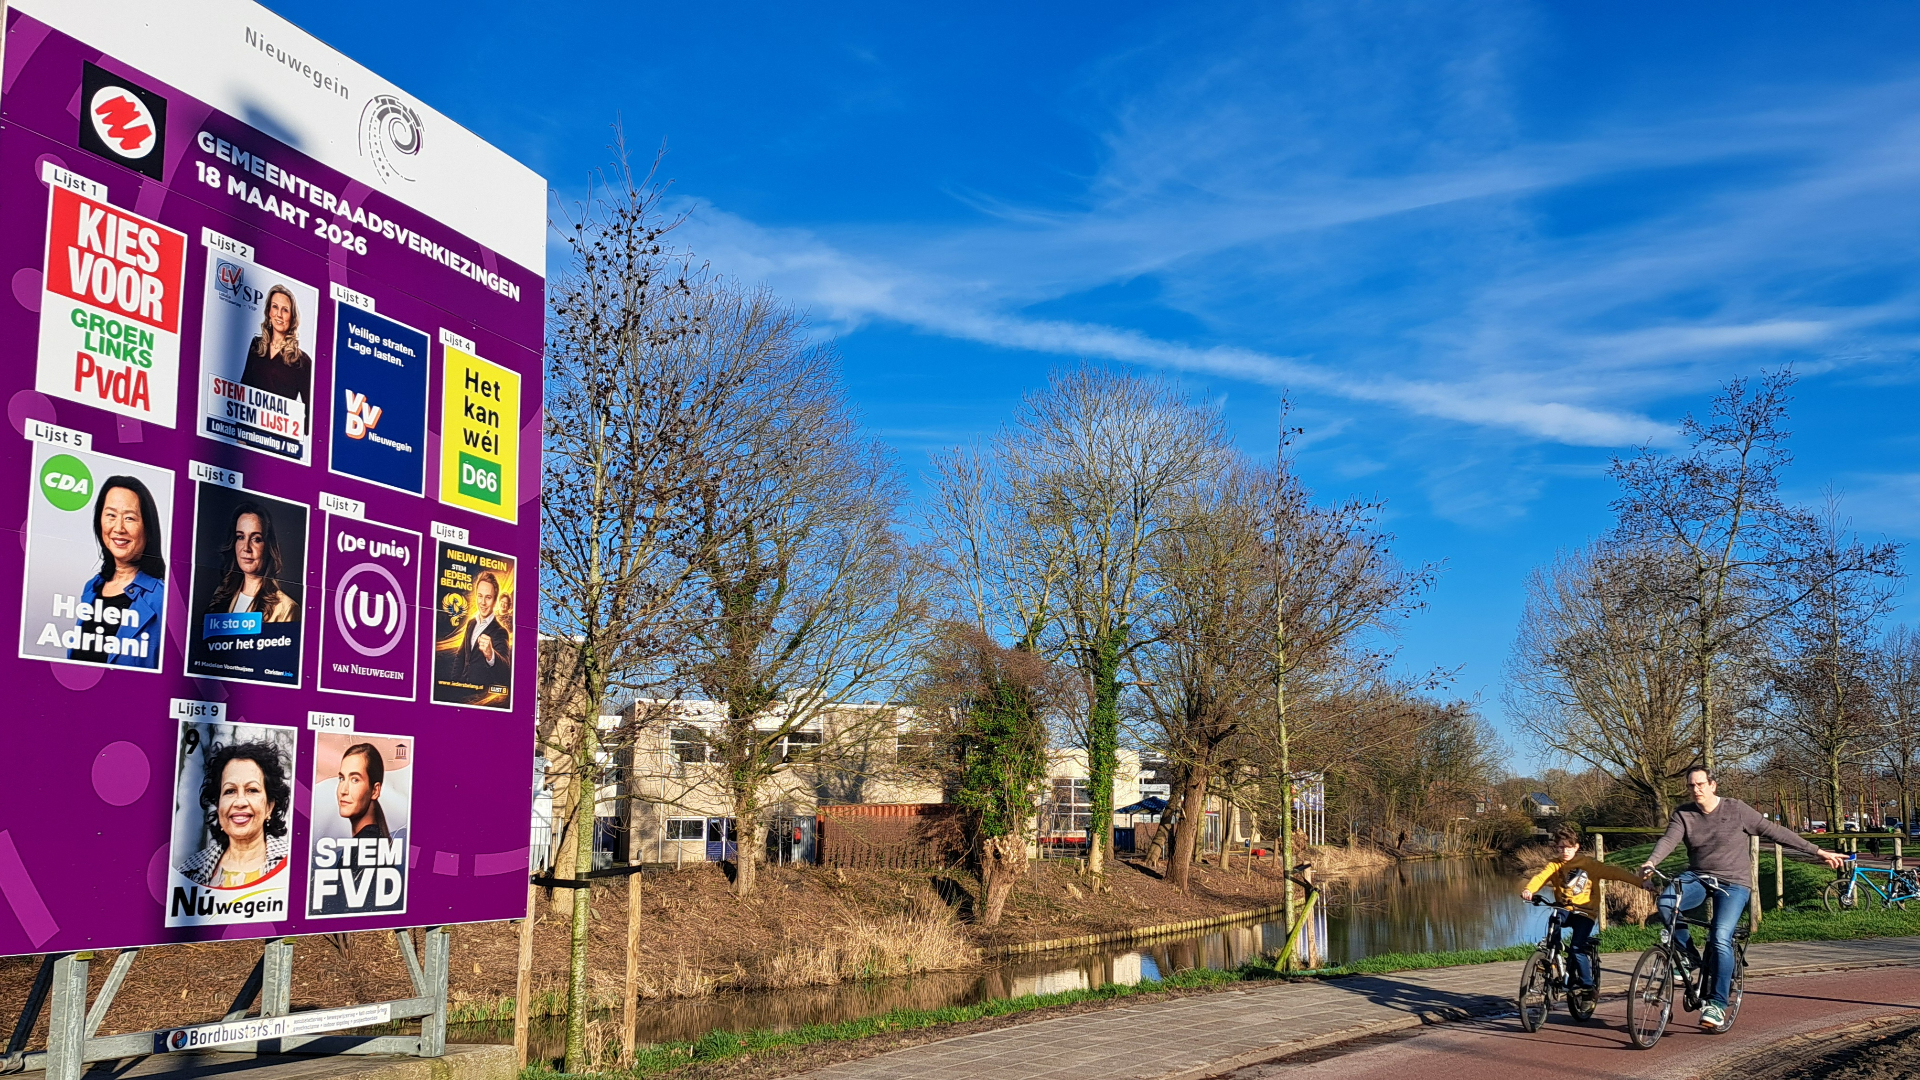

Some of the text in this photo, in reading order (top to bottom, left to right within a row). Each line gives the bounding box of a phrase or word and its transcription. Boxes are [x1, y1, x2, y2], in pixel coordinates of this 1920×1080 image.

[245, 26, 349, 100] Nieuwegein
[54, 168, 97, 196] Lijst 1
[195, 160, 367, 256] 18 MAART 2026
[197, 131, 520, 302] GEMEENTERAADSVERKIEZINGEN
[77, 201, 160, 273] KIES
[209, 232, 247, 258] Lijst 2
[68, 245, 164, 323] VOOR
[232, 283, 264, 306] VSP
[336, 286, 369, 308] Lijst 3
[70, 308, 155, 351] GROEN
[348, 322, 416, 358] Veilige straten.
[444, 331, 471, 351] Lijst 4
[84, 331, 153, 368] LINKS
[347, 337, 405, 368] Lage lasten.
[74, 350, 151, 412] PvdA
[465, 367, 501, 403] Het
[213, 377, 290, 417] STEM LOKAAL
[226, 400, 300, 437] STEM LIJST 2
[464, 394, 499, 429] kan
[35, 423, 83, 446] Lijst 5
[211, 420, 236, 436] Lokale
[237, 427, 280, 450] Vernieuwing
[286, 442, 300, 455] VSP
[368, 431, 413, 454] Nieuwegein
[463, 427, 499, 456] wél
[44, 471, 89, 495] CDA
[196, 464, 236, 485] Lijst 6
[462, 462, 498, 493] D66
[326, 495, 359, 513] Lijst 7
[436, 524, 464, 540] Lijst 8
[446, 548, 507, 572] NIEUW BEGIN
[451, 563, 467, 573] STEM
[440, 577, 473, 591] BELANG
[444, 569, 472, 583] IEDERS
[52, 593, 140, 628] Helen
[209, 618, 256, 631] Ik sta op
[36, 622, 150, 658] Adriani
[208, 635, 292, 651] voor het goede
[178, 702, 219, 717] Lijst 9
[311, 714, 351, 728] Lijst 10
[185, 728, 200, 755] 9
[315, 837, 403, 868] STEM
[312, 867, 402, 910] FVD
[190, 1019, 286, 1047] Bordbusters.nl
